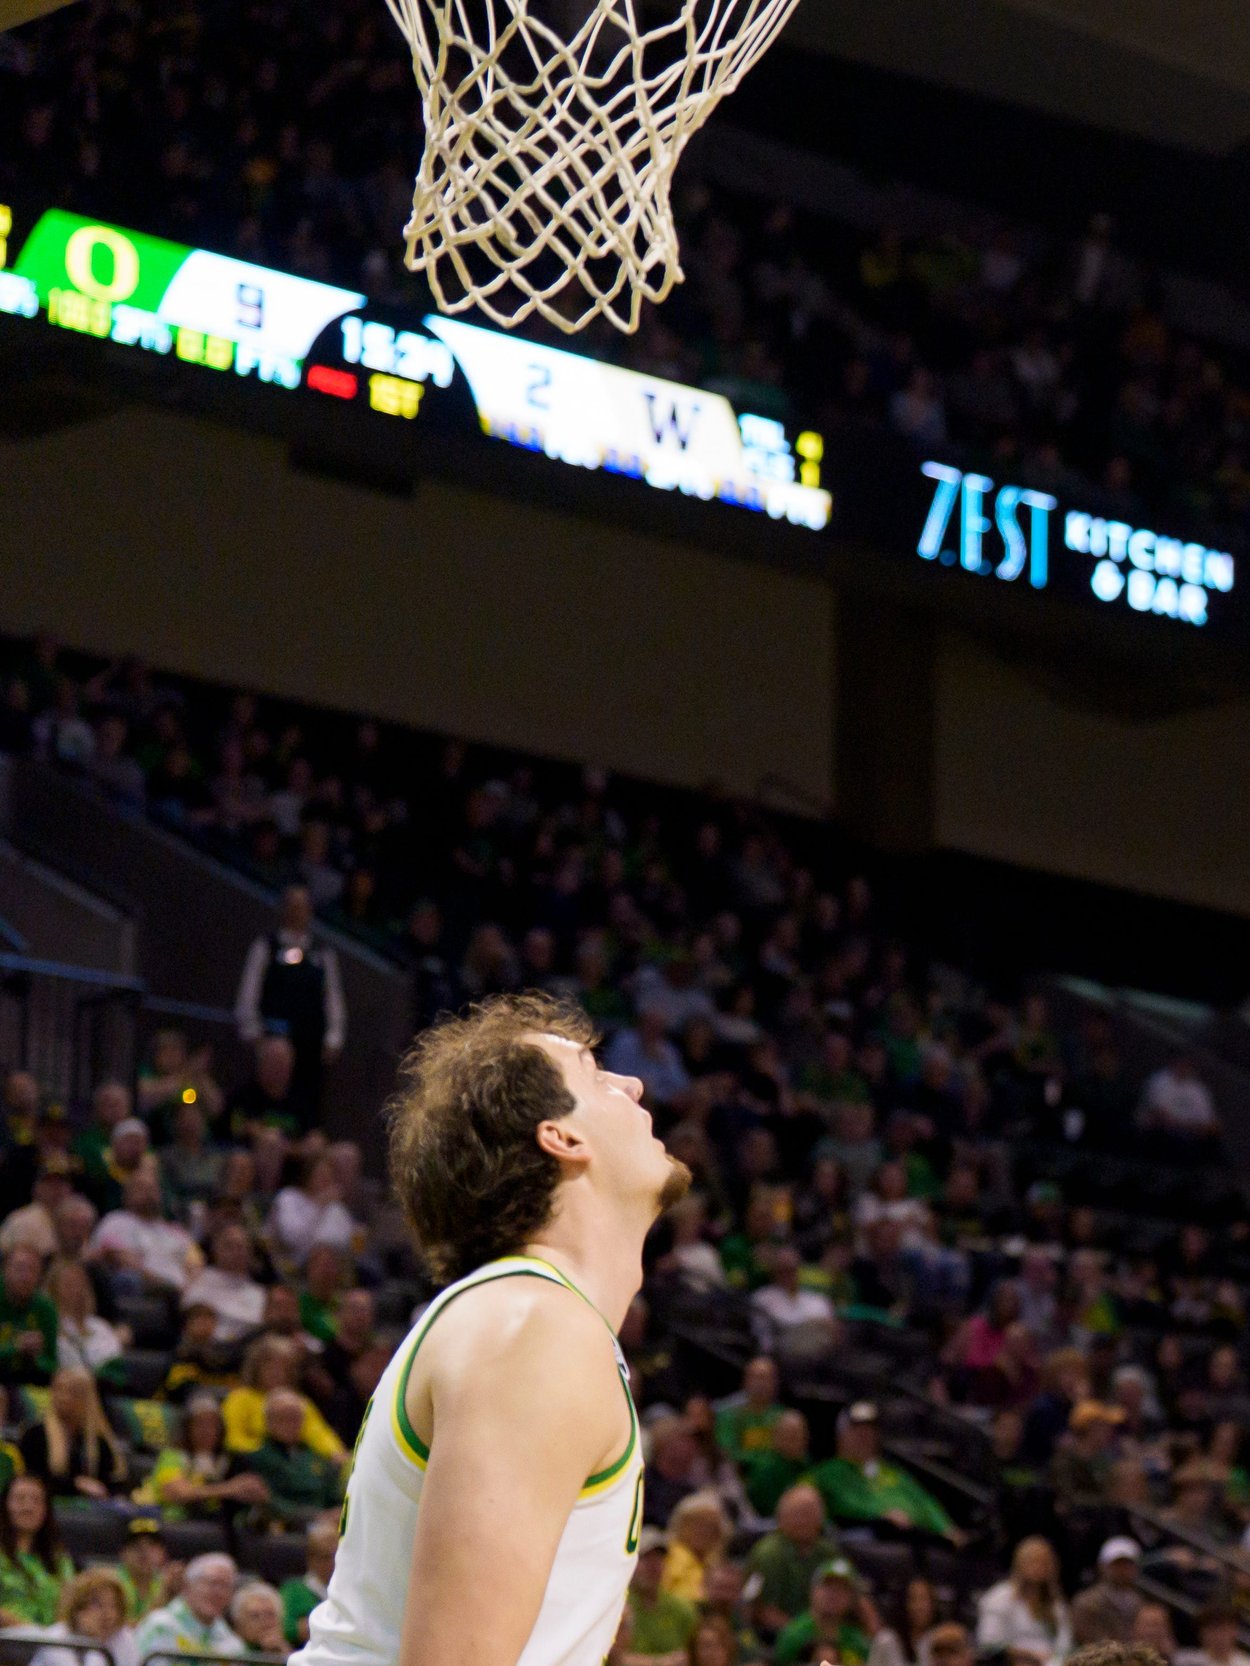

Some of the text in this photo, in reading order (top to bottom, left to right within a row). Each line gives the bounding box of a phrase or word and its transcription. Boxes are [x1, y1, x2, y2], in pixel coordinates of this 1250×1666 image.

[65, 225, 140, 303] O
[235, 281, 264, 329] 9
[525, 362, 553, 411] 2
[641, 390, 703, 451] W
[917, 460, 1058, 590] ZEST
[1064, 509, 1235, 593] KITCHEN
[1127, 568, 1209, 626] BAR
